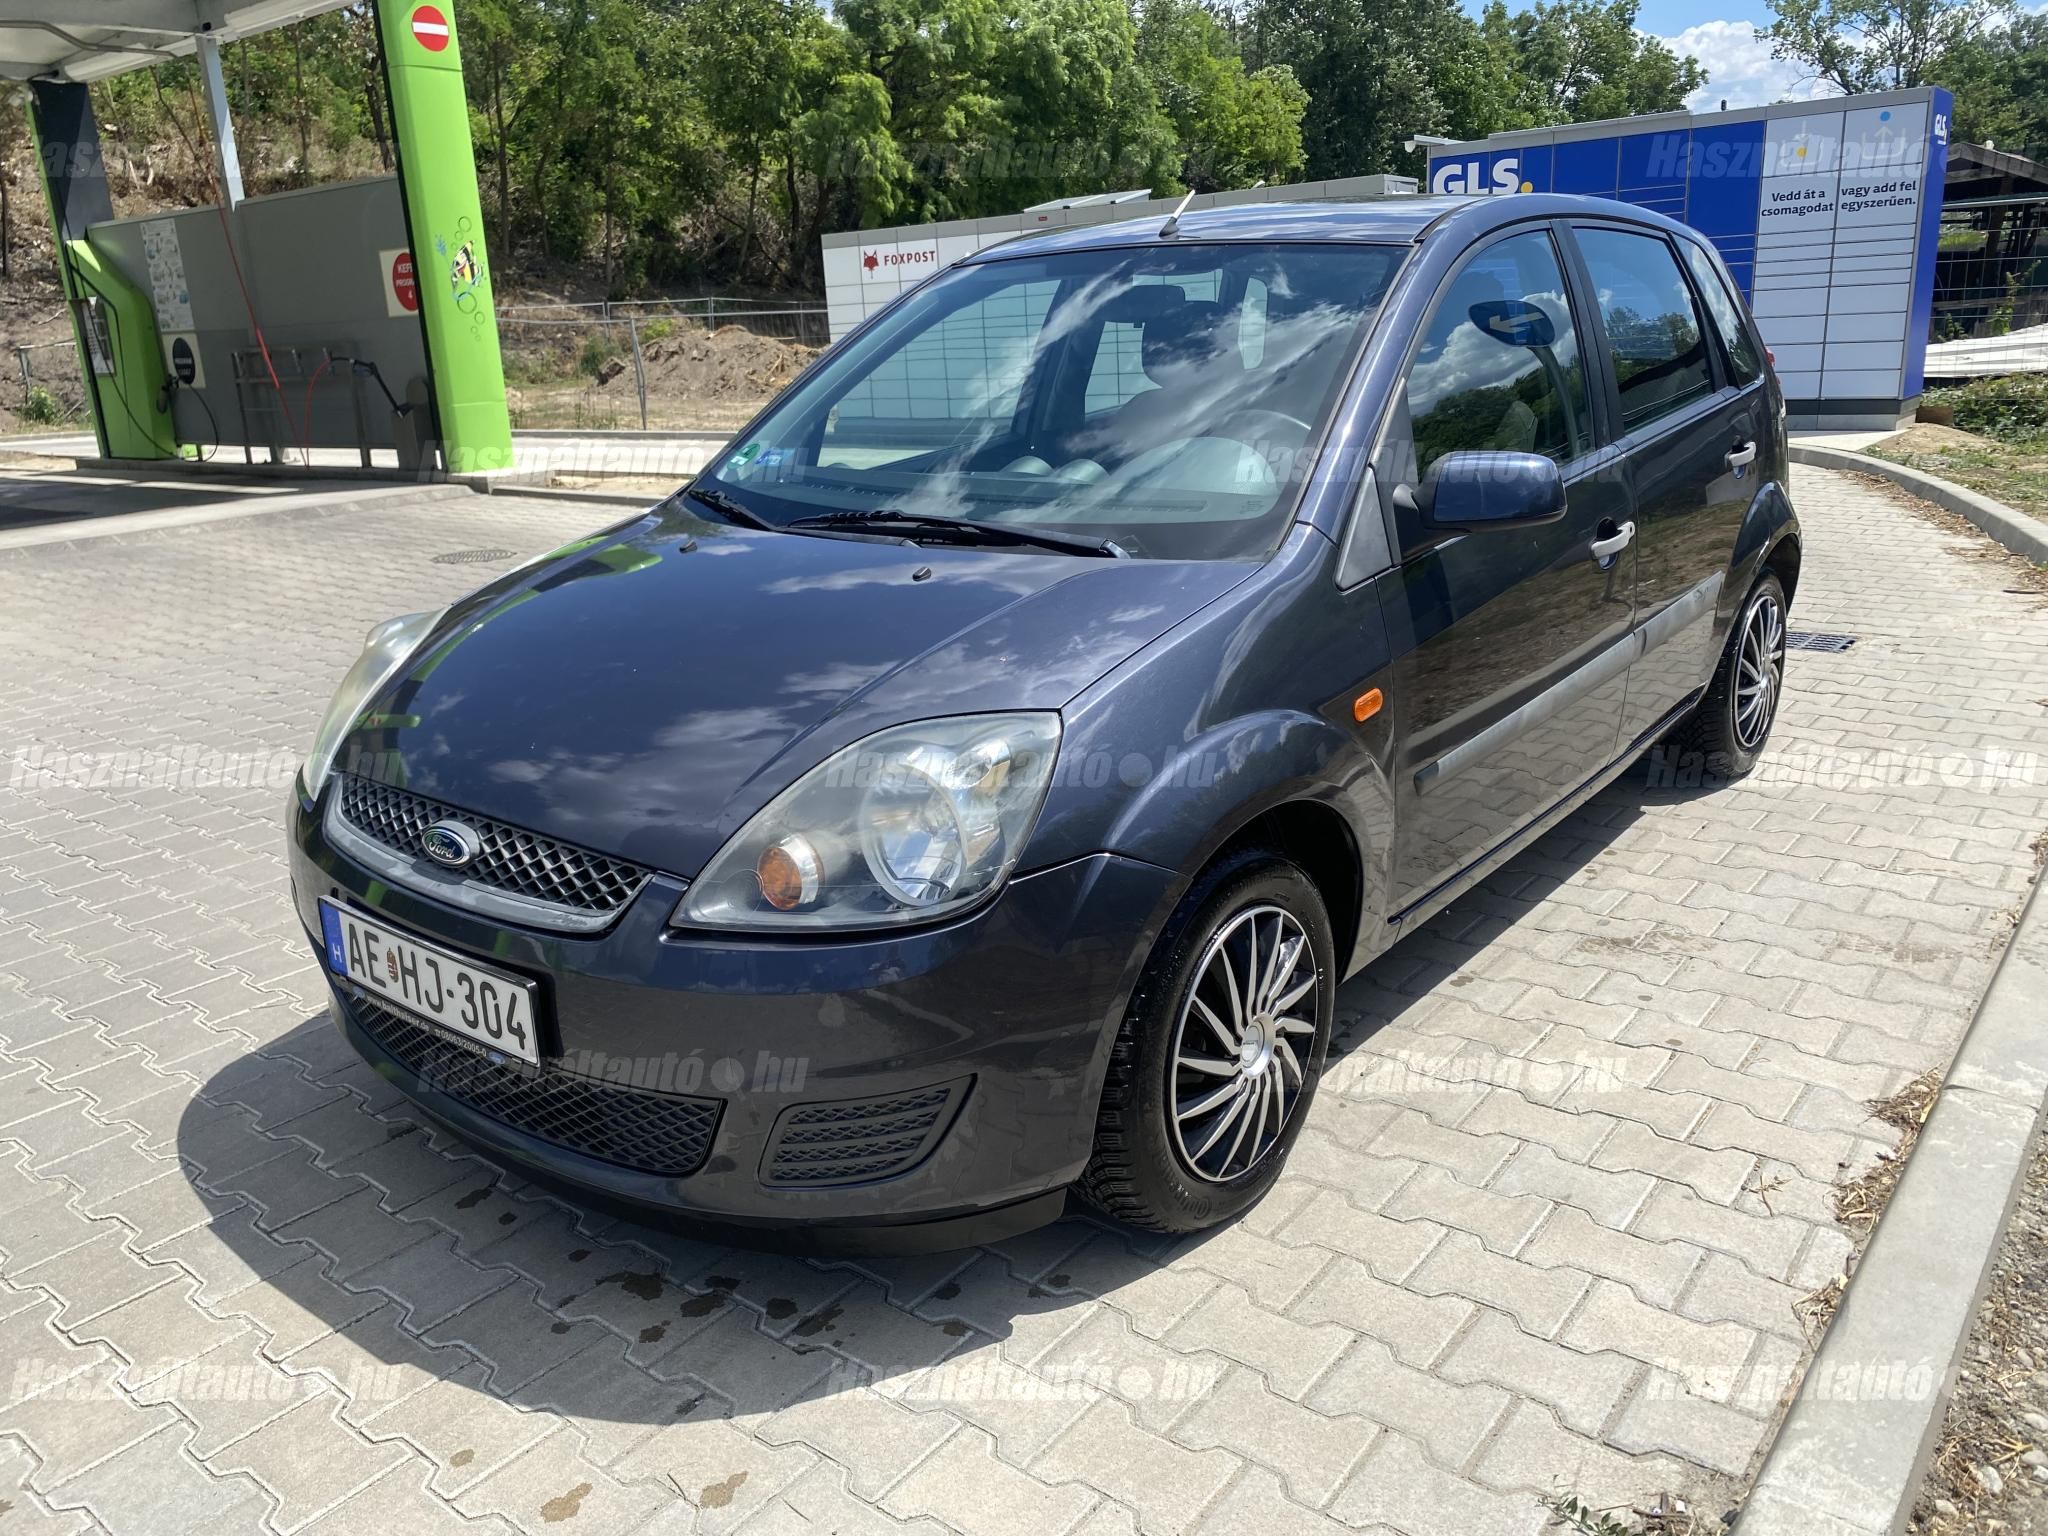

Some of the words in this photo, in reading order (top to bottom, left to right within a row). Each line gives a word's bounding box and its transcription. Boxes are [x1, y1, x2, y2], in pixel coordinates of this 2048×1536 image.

[1771, 190, 1801, 202] Vedd
[1803, 188, 1816, 200] át
[1817, 190, 1826, 199] a
[1841, 184, 1871, 198] vagy
[1873, 182, 1896, 194] add
[1899, 180, 1916, 191] fel
[1761, 202, 1834, 217] csomagodat
[1841, 195, 1916, 212] egyszerűen.
[884, 250, 936, 267] FOXPOST
[428, 836, 456, 860] Ford
[331, 942, 342, 959] H
[348, 922, 387, 989] AE
[397, 944, 527, 1051] HJ-304
